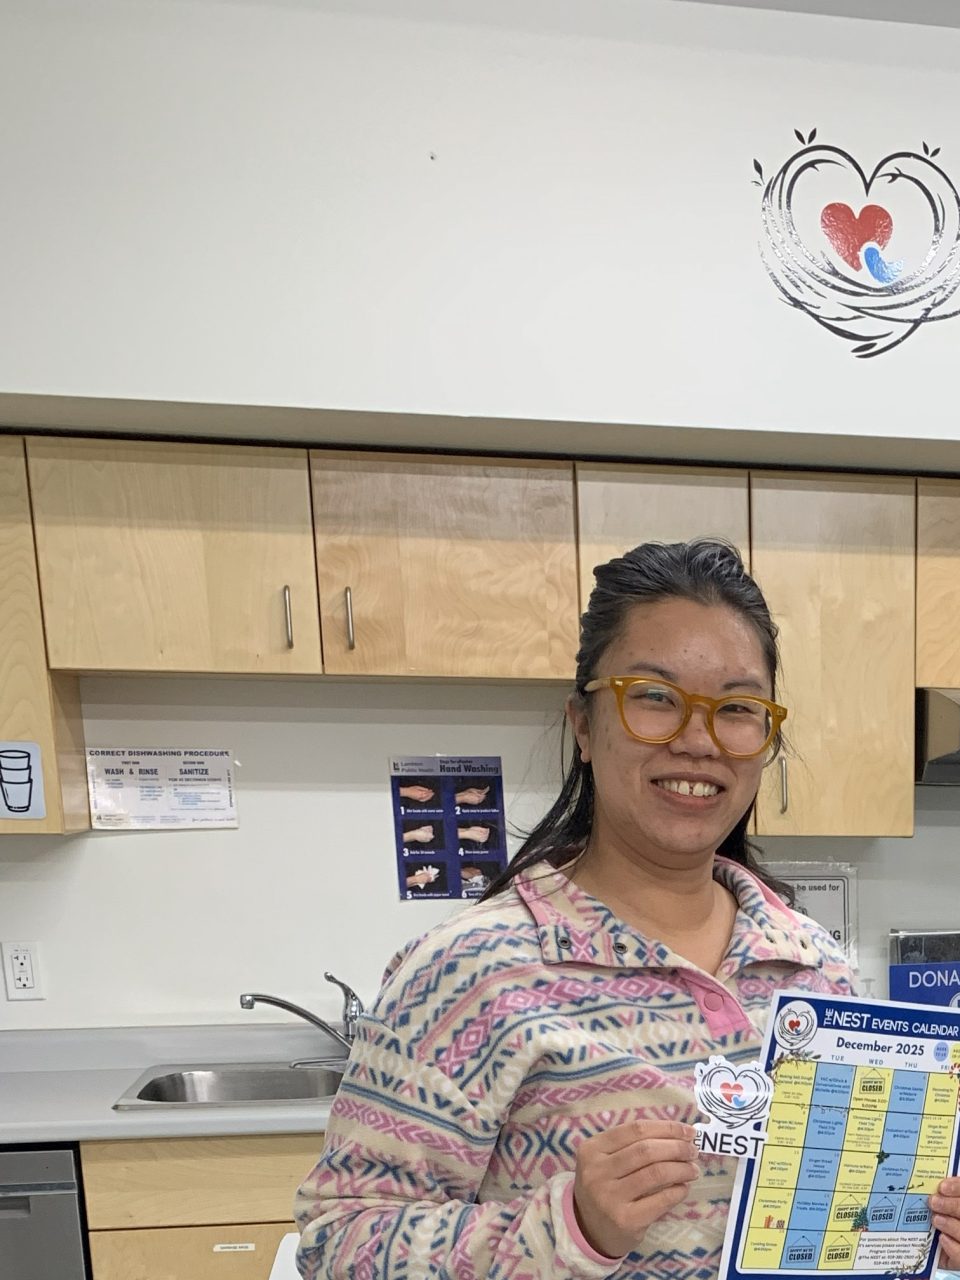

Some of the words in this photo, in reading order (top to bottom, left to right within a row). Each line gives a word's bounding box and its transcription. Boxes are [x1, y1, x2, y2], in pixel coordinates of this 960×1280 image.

[463, 764, 498, 774] Washing
[400, 806, 405, 815] 1
[455, 806, 461, 815] 2
[403, 848, 409, 856] 3
[458, 848, 464, 856] 4
[824, 1008, 833, 1025] THE
[833, 1010, 871, 1028] NEST
[872, 1018, 909, 1032] EVENTS
[912, 1022, 960, 1036] CALENDAR
[836, 1036, 892, 1054] December
[896, 1042, 925, 1056] 2025
[701, 1131, 764, 1157] NEST
